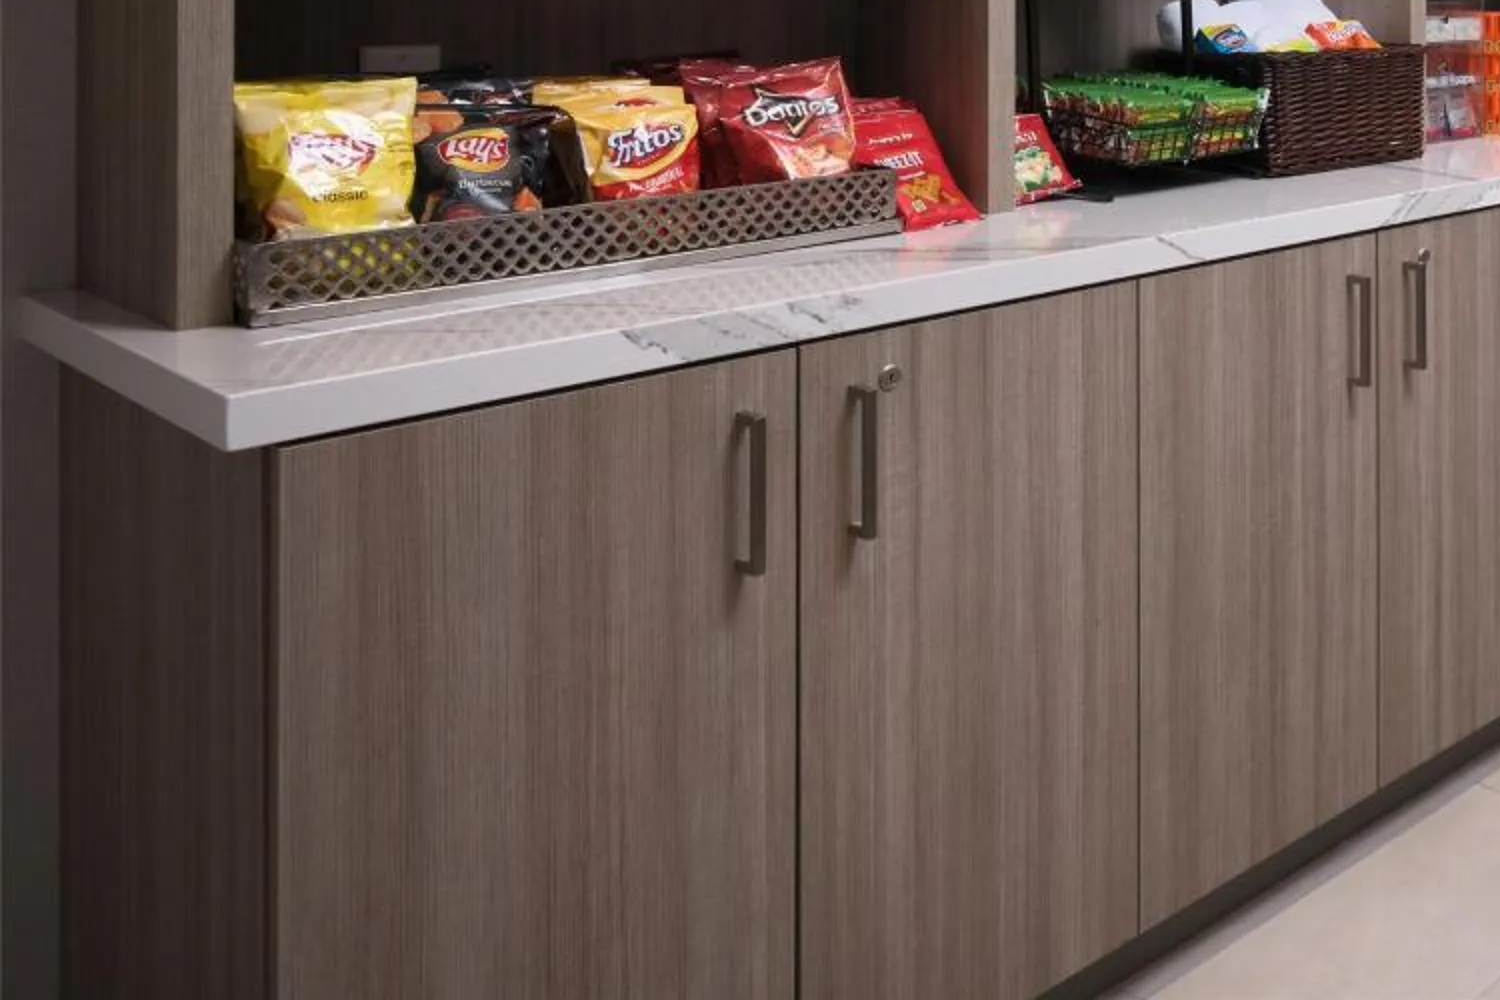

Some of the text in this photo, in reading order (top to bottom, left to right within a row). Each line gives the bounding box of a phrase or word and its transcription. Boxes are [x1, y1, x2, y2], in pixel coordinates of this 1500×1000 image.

[744, 95, 840, 127] Doritos
[446, 135, 509, 165] Lay's
[607, 123, 684, 168] Fritos
